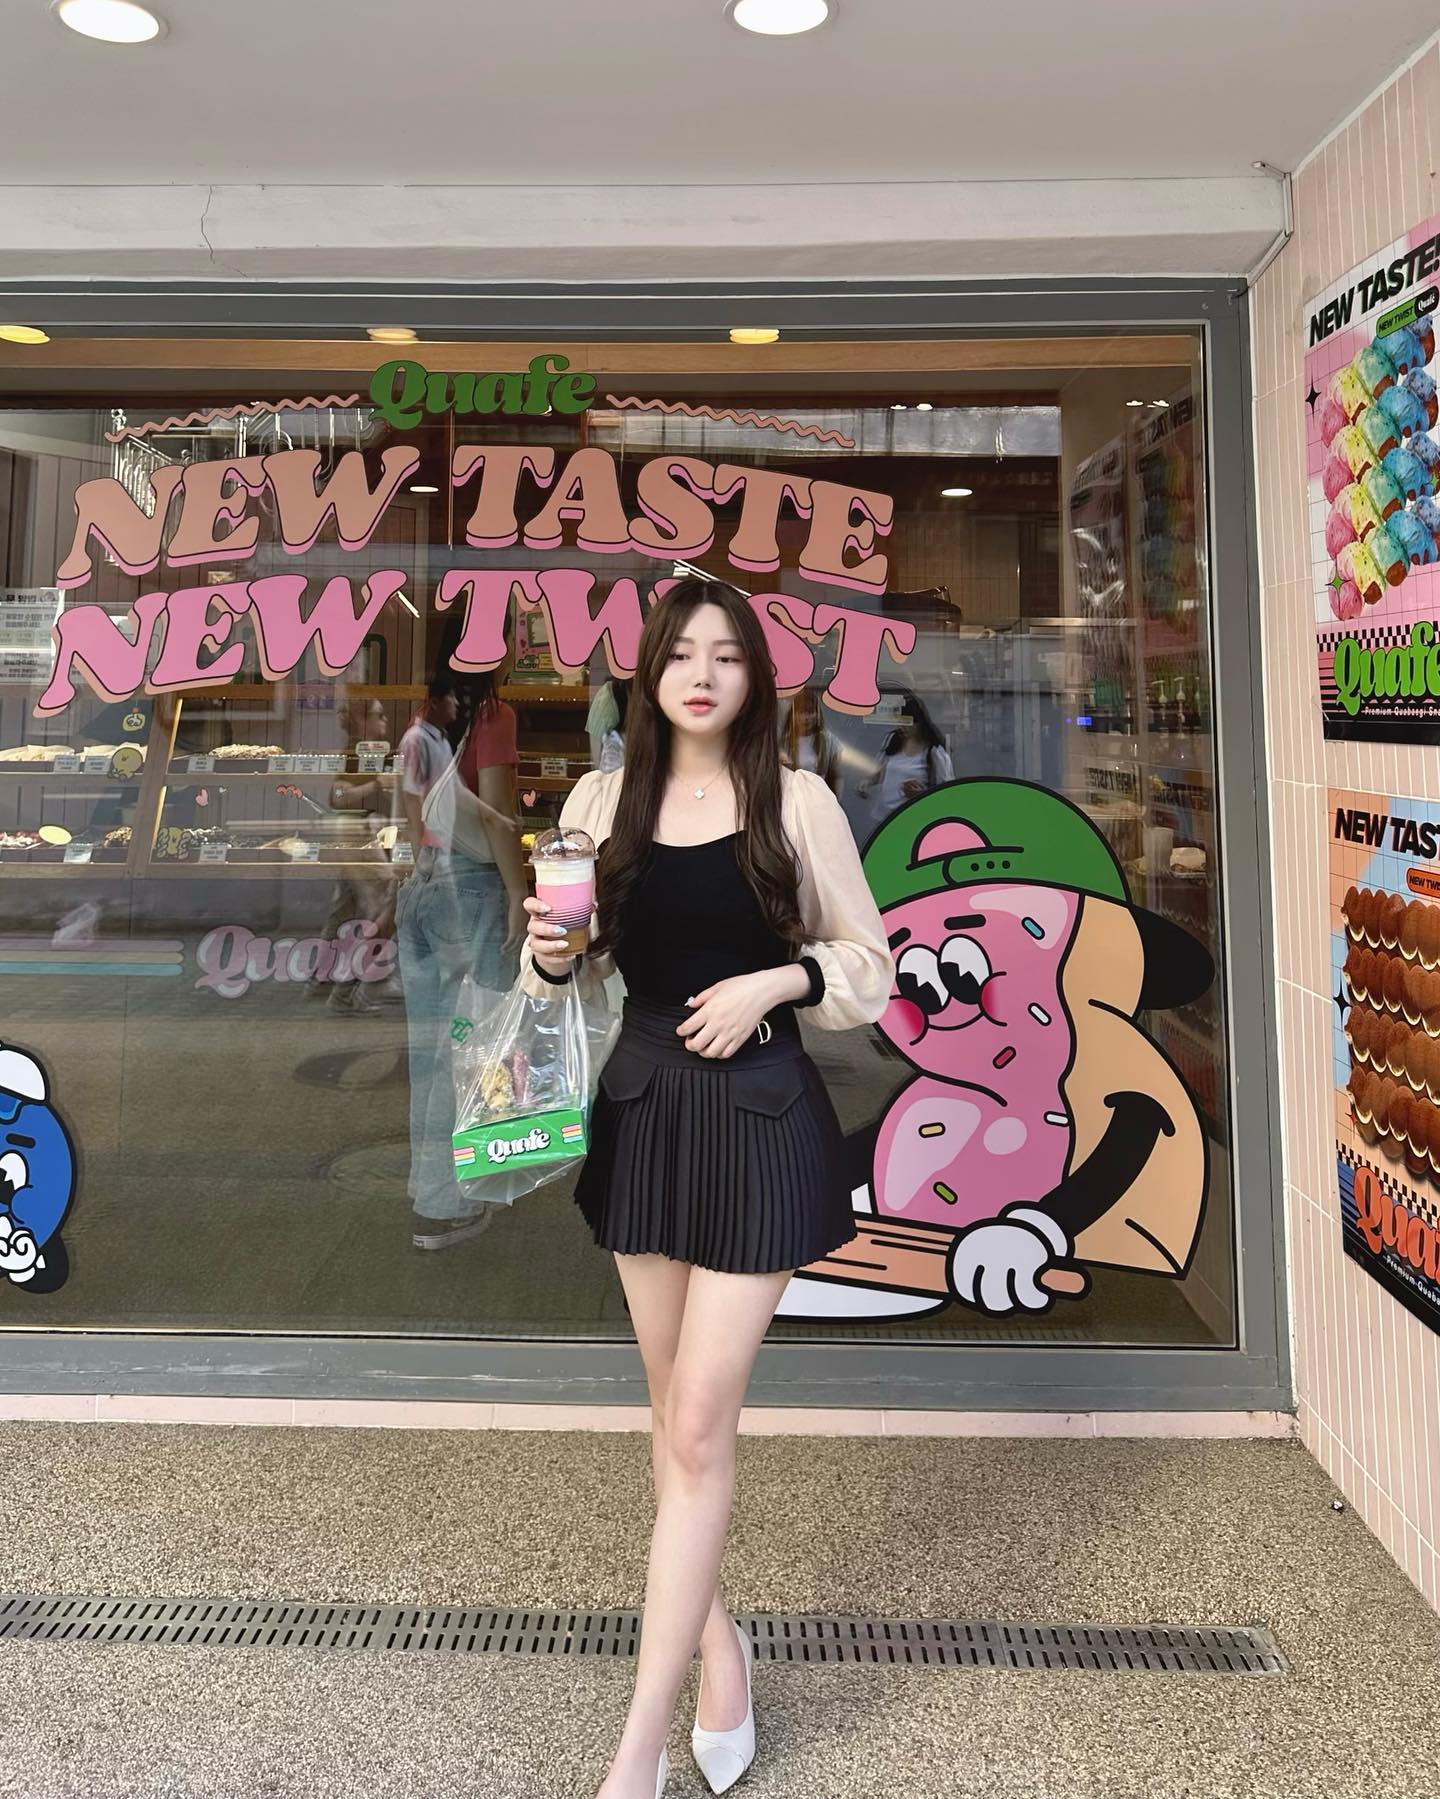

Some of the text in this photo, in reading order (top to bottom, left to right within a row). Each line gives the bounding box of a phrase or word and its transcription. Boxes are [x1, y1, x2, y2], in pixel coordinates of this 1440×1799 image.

[1310, 232, 1440, 348] NEW TASTE!
[1378, 305, 1414, 334] NEW TWIST
[368, 354, 599, 430] Quafe
[56, 445, 894, 596] NEW TASTE
[32, 567, 917, 719] NEW TWST
[1334, 807, 1389, 848] NEW
[1408, 875, 1426, 888] NEW
[194, 918, 398, 999] Quafe
[486, 1127, 551, 1165] Quafe
[1353, 1165, 1440, 1285] Qua
